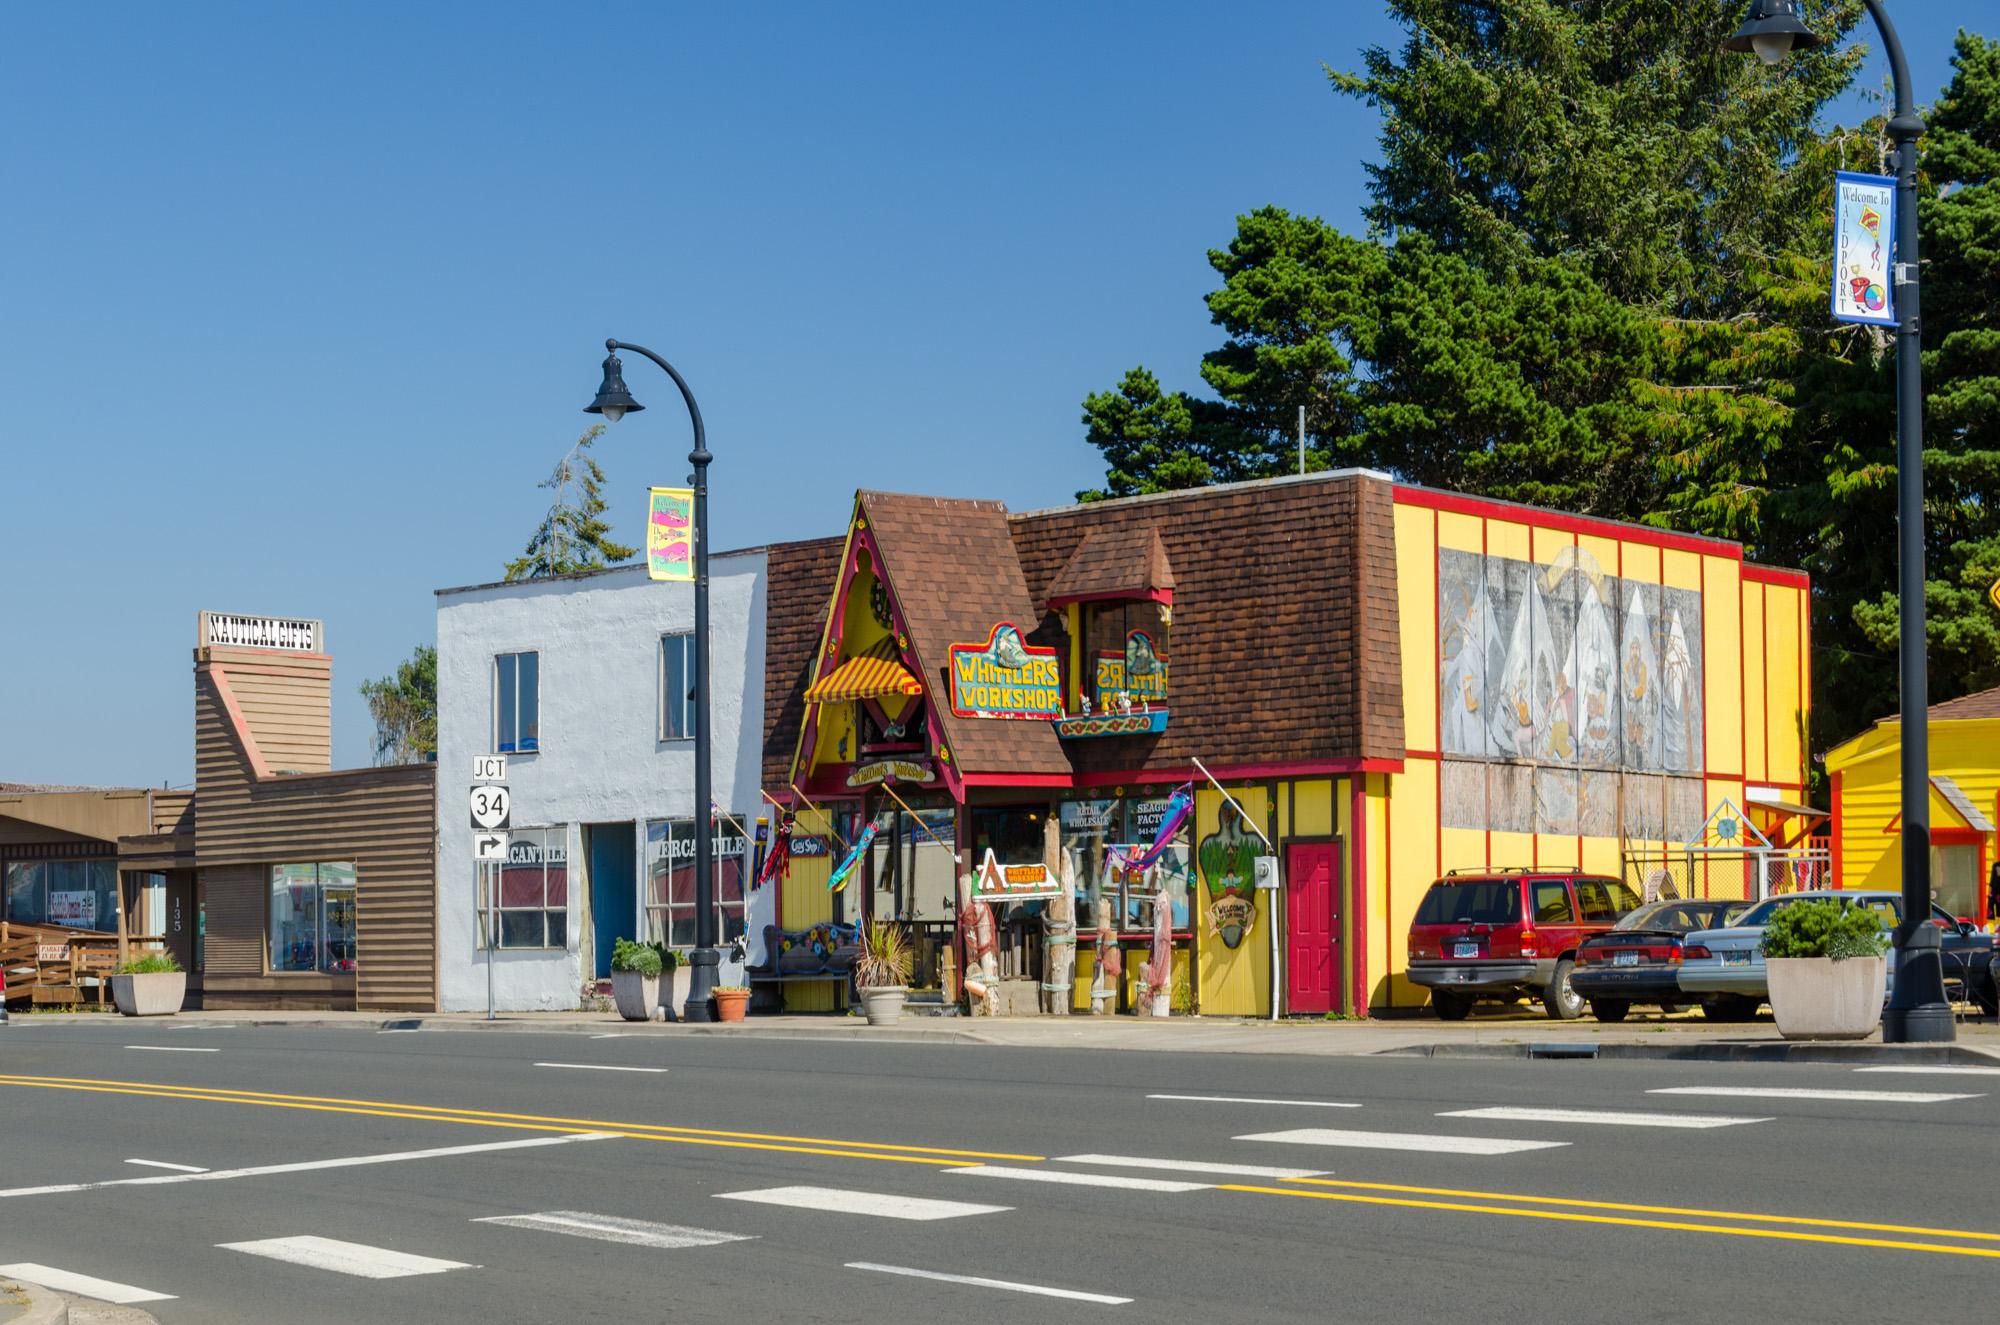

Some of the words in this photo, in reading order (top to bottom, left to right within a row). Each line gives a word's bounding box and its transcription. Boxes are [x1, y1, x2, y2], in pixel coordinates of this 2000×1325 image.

[1842, 187, 1877, 204] Welcome
[1880, 191, 1889, 206] To
[210, 615, 276, 647] NAUTICAL
[279, 621, 312, 650] GIFTS
[955, 656, 1060, 686] WHITTLERS
[960, 687, 1058, 710] WORKSHOP
[475, 760, 504, 777] JCT
[476, 794, 504, 816] 34
[1076, 805, 1100, 816] RETAIL
[1137, 803, 1167, 814] SEAGU
[1069, 816, 1109, 828] WHOLESALE
[1137, 814, 1166, 825] FACTO
